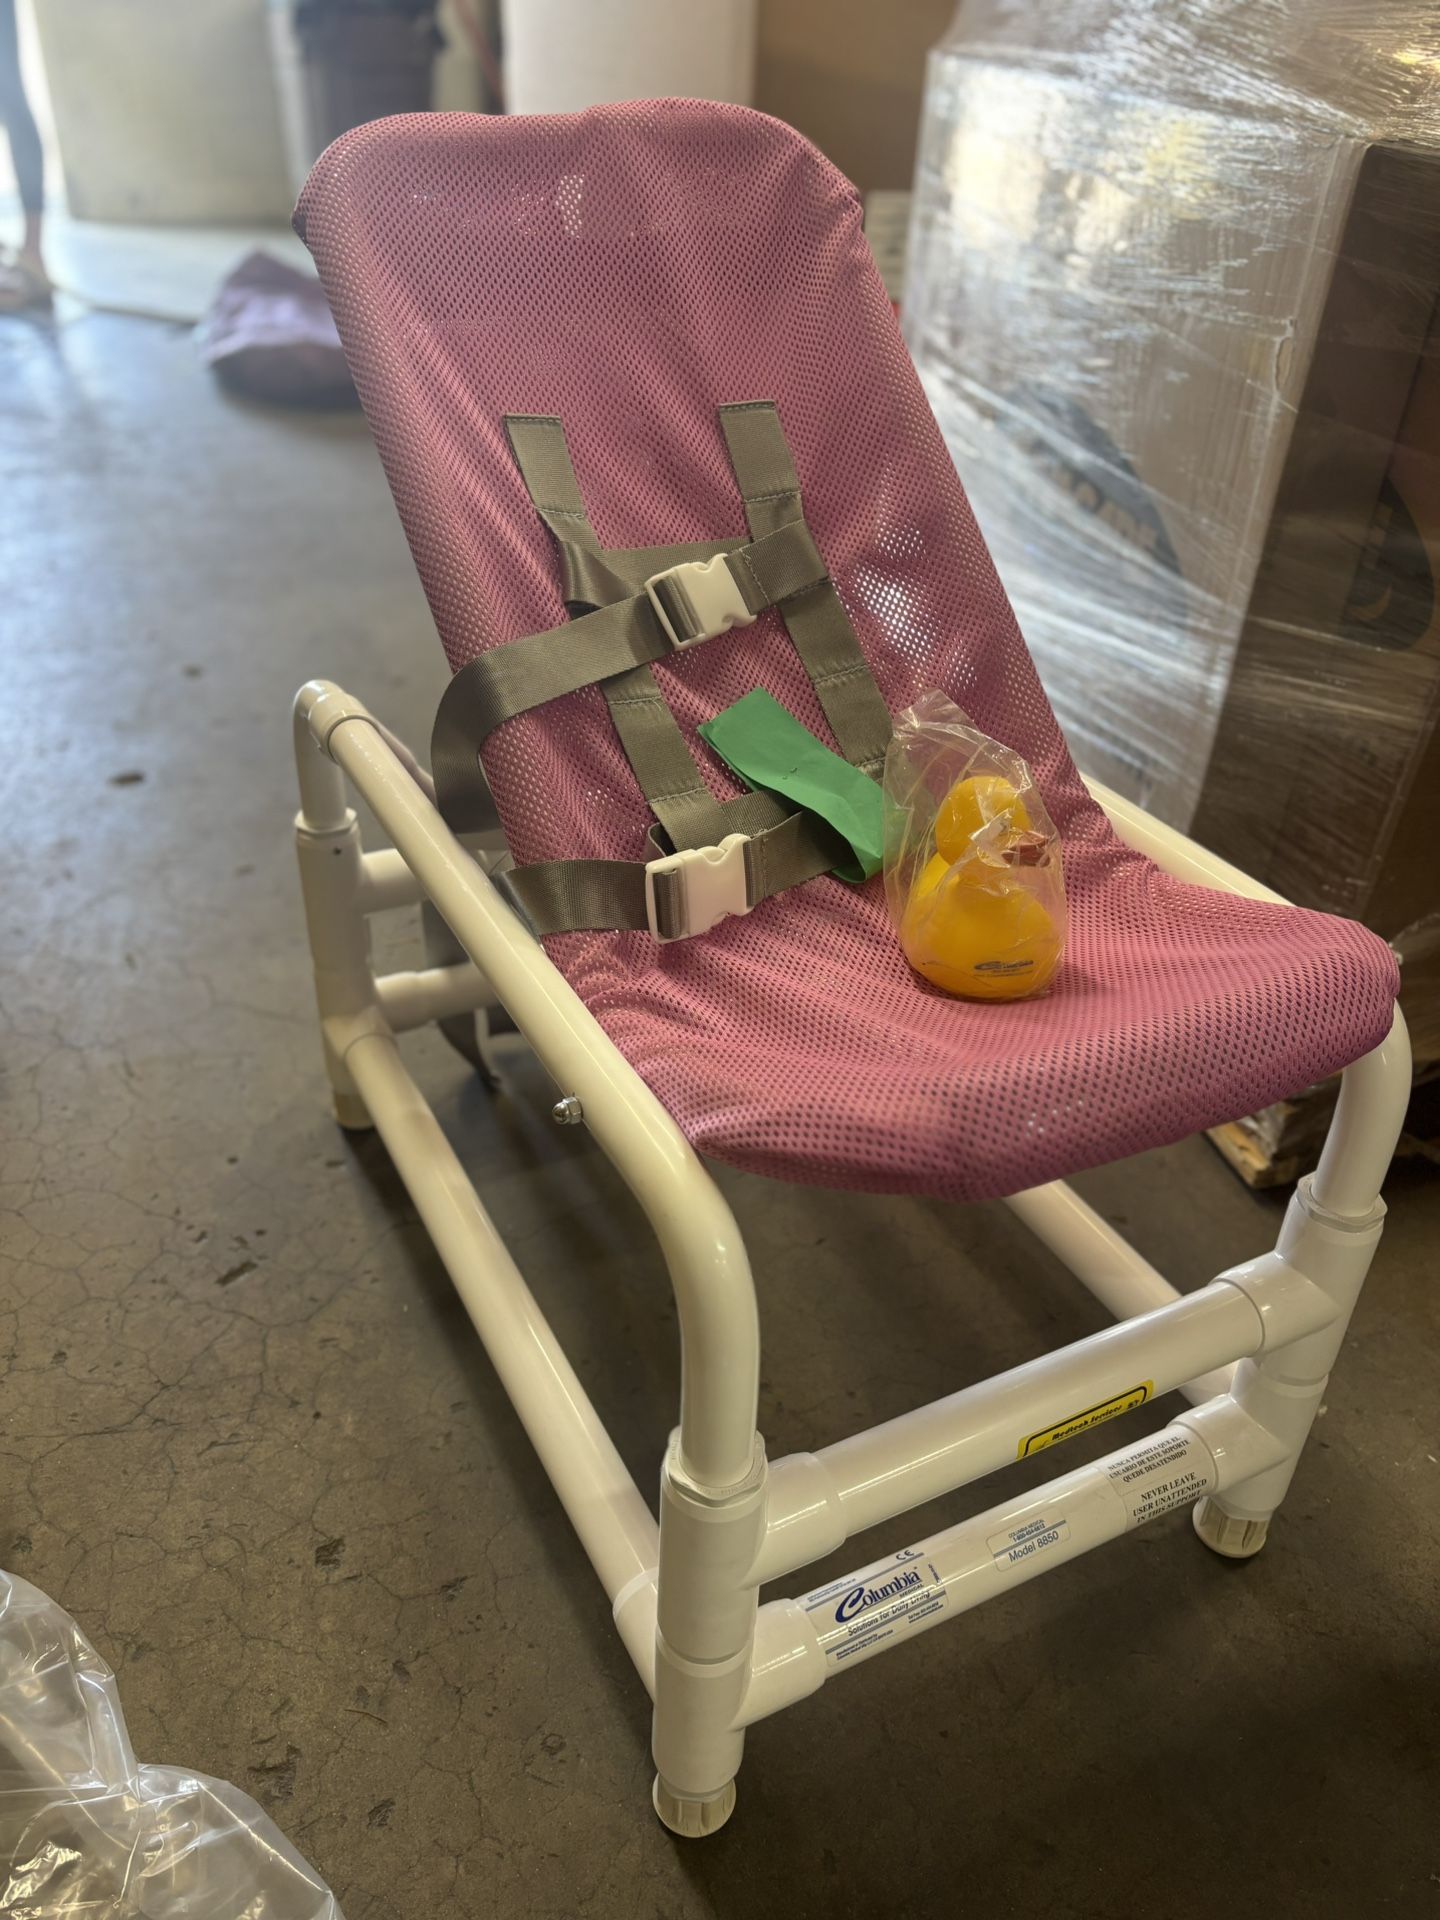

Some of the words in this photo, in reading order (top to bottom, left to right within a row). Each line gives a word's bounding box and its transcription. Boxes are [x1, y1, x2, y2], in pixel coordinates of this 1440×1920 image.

[1107, 1458, 1130, 1471] NUNCA
[1130, 1447, 1157, 1464] PERMITA
[1158, 1440, 1172, 1450] QUE
[1109, 1463, 1137, 1479] USUARIO
[1137, 1458, 1146, 1467] DE
[1146, 1451, 1162, 1464] ESTE
[1162, 1439, 1190, 1456] SOPORTE
[1123, 1468, 1145, 1483] QUEDE
[1145, 1450, 1187, 1473] DESATENDIDO
[1133, 1502, 1154, 1517] USER
[1155, 1479, 1208, 1507] UNATTENDED
[1141, 1484, 1169, 1502] NEVER
[1169, 1472, 1197, 1489] LEAVE
[1137, 1514, 1147, 1523] IN
[1147, 1506, 1166, 1519] THIS
[1166, 1490, 1202, 1509] SUPPORT
[1008, 1541, 1036, 1562] Model
[1036, 1530, 1059, 1548] 8850
[835, 1570, 921, 1623] Columbia
[899, 1583, 924, 1598] MEDICAL
[848, 1616, 879, 1637] Solutions
[879, 1611, 890, 1621] for
